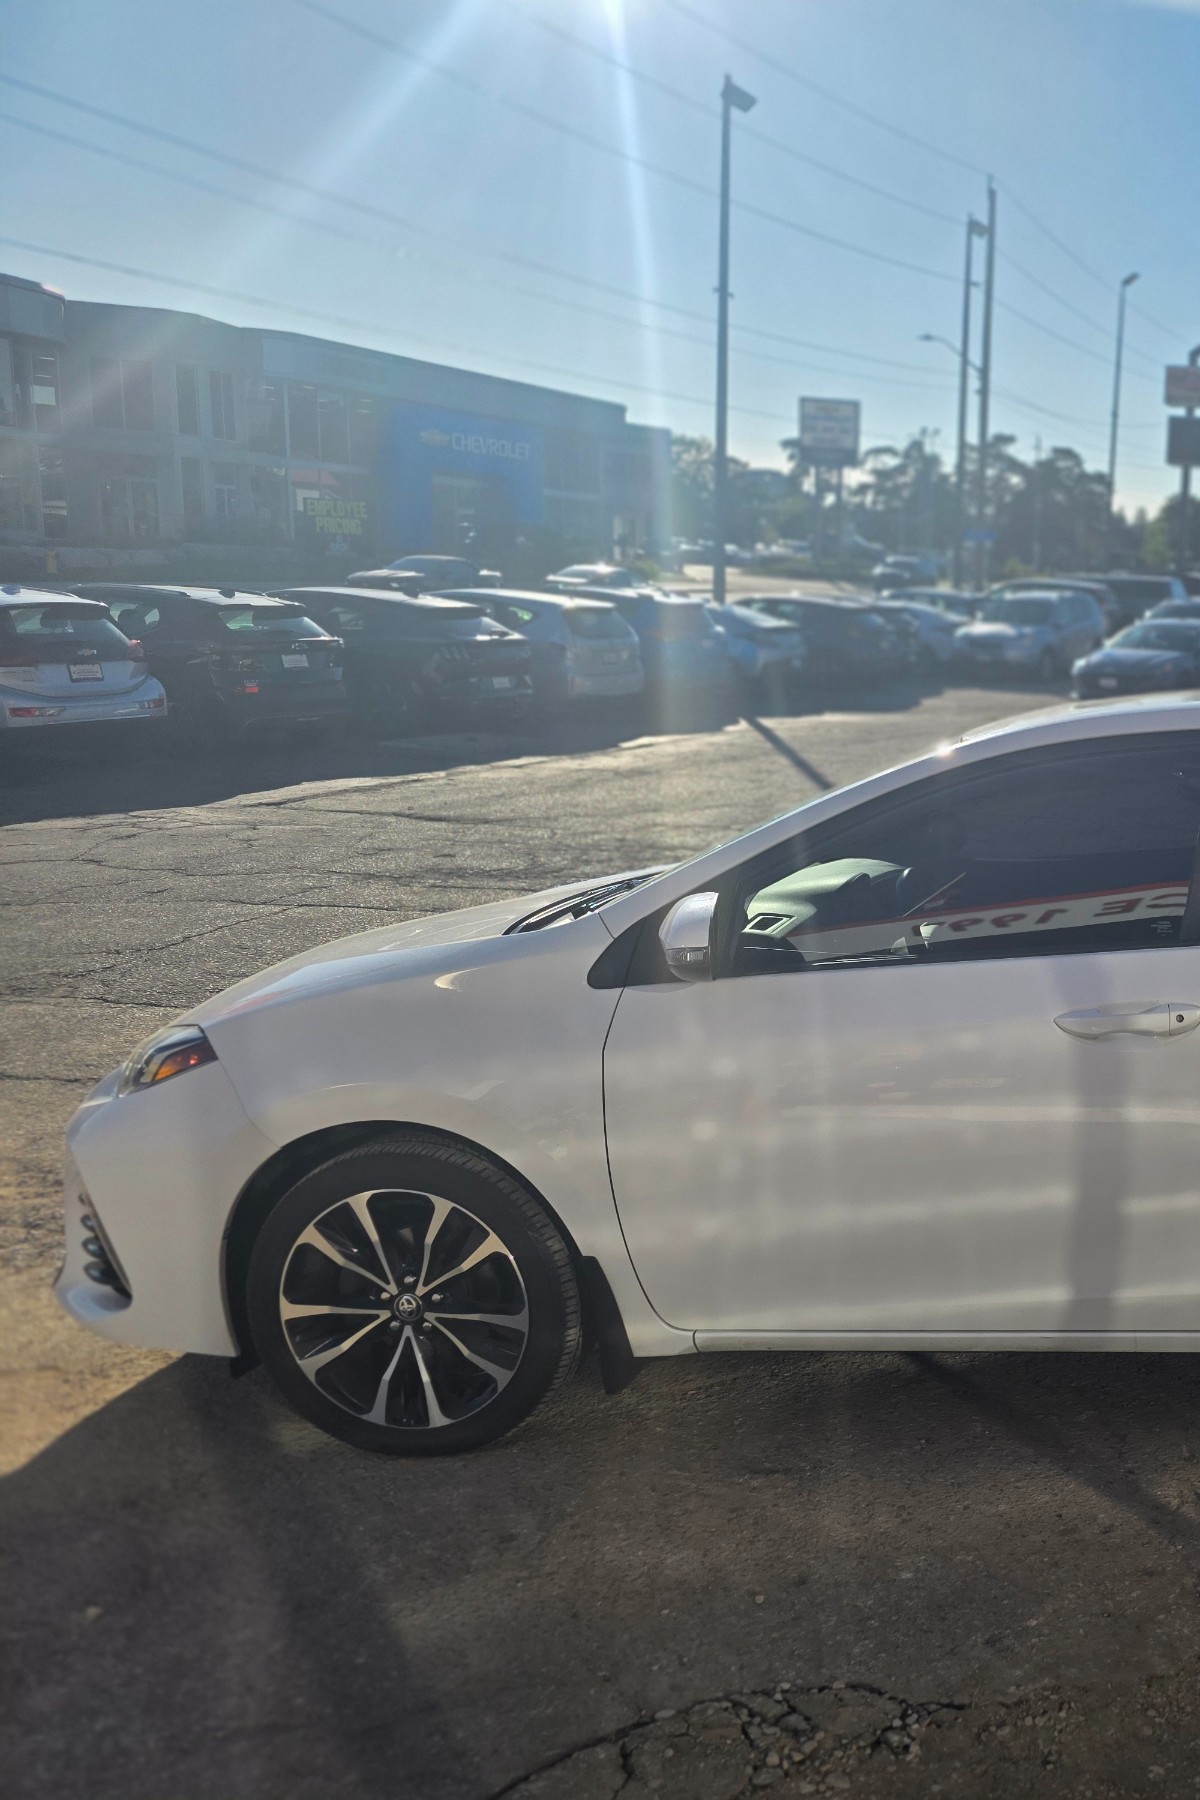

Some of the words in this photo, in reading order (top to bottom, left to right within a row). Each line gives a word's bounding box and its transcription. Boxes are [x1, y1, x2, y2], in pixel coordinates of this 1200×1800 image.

[452, 432, 532, 460] CHEVROLET
[307, 498, 368, 519] EMPLOYEE
[315, 516, 362, 535] PRICING
